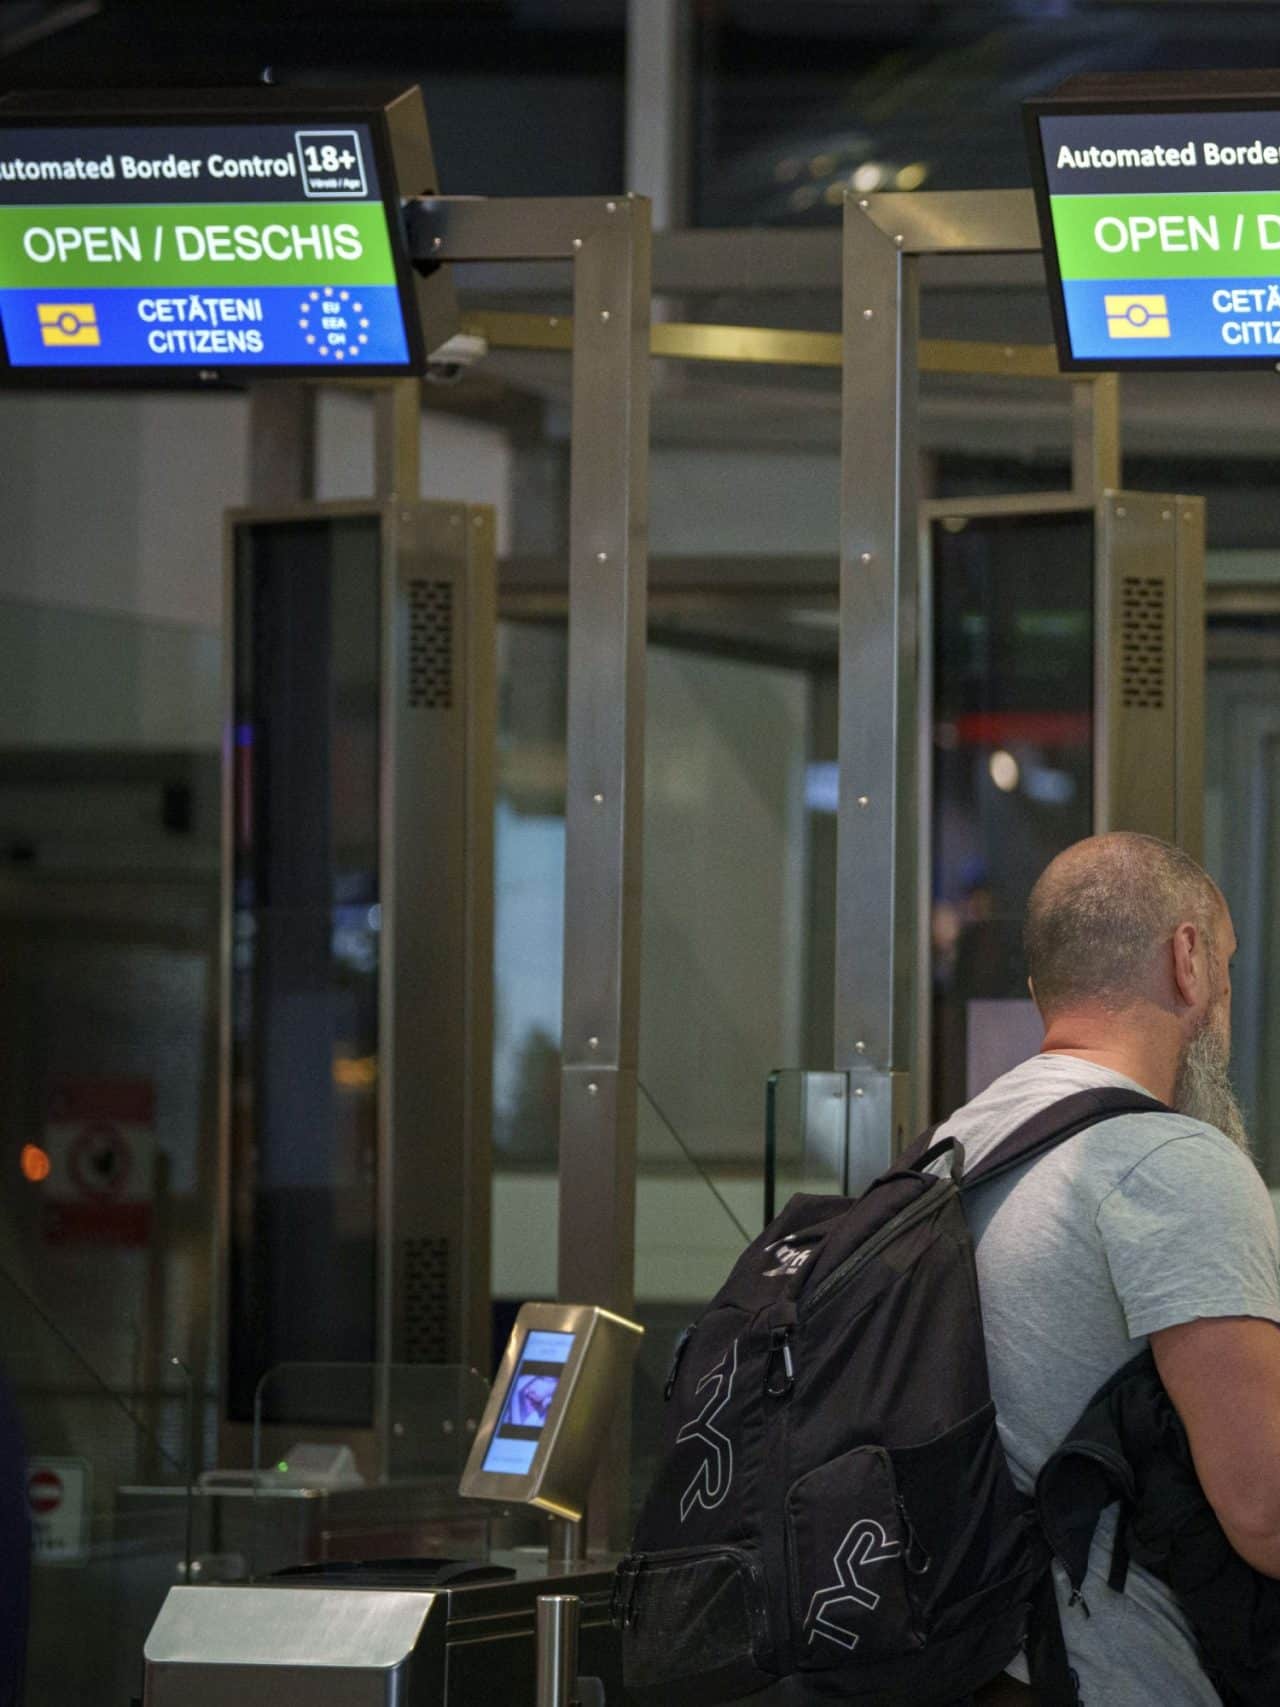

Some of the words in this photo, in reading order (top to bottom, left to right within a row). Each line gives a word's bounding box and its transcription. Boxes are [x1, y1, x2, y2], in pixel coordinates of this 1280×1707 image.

[0, 154, 115, 179] utomated
[121, 155, 201, 178] Border
[208, 153, 297, 177] Control
[304, 145, 356, 172] 18+
[1057, 142, 1196, 168] Automated
[23, 227, 142, 262] OPEN
[154, 226, 162, 261] /
[175, 224, 363, 261] DESCHIS
[1094, 215, 1220, 253] OPEN
[1233, 214, 1245, 252] /
[148, 328, 263, 354] CITIZENS
[802, 1519, 900, 1650] TYR
